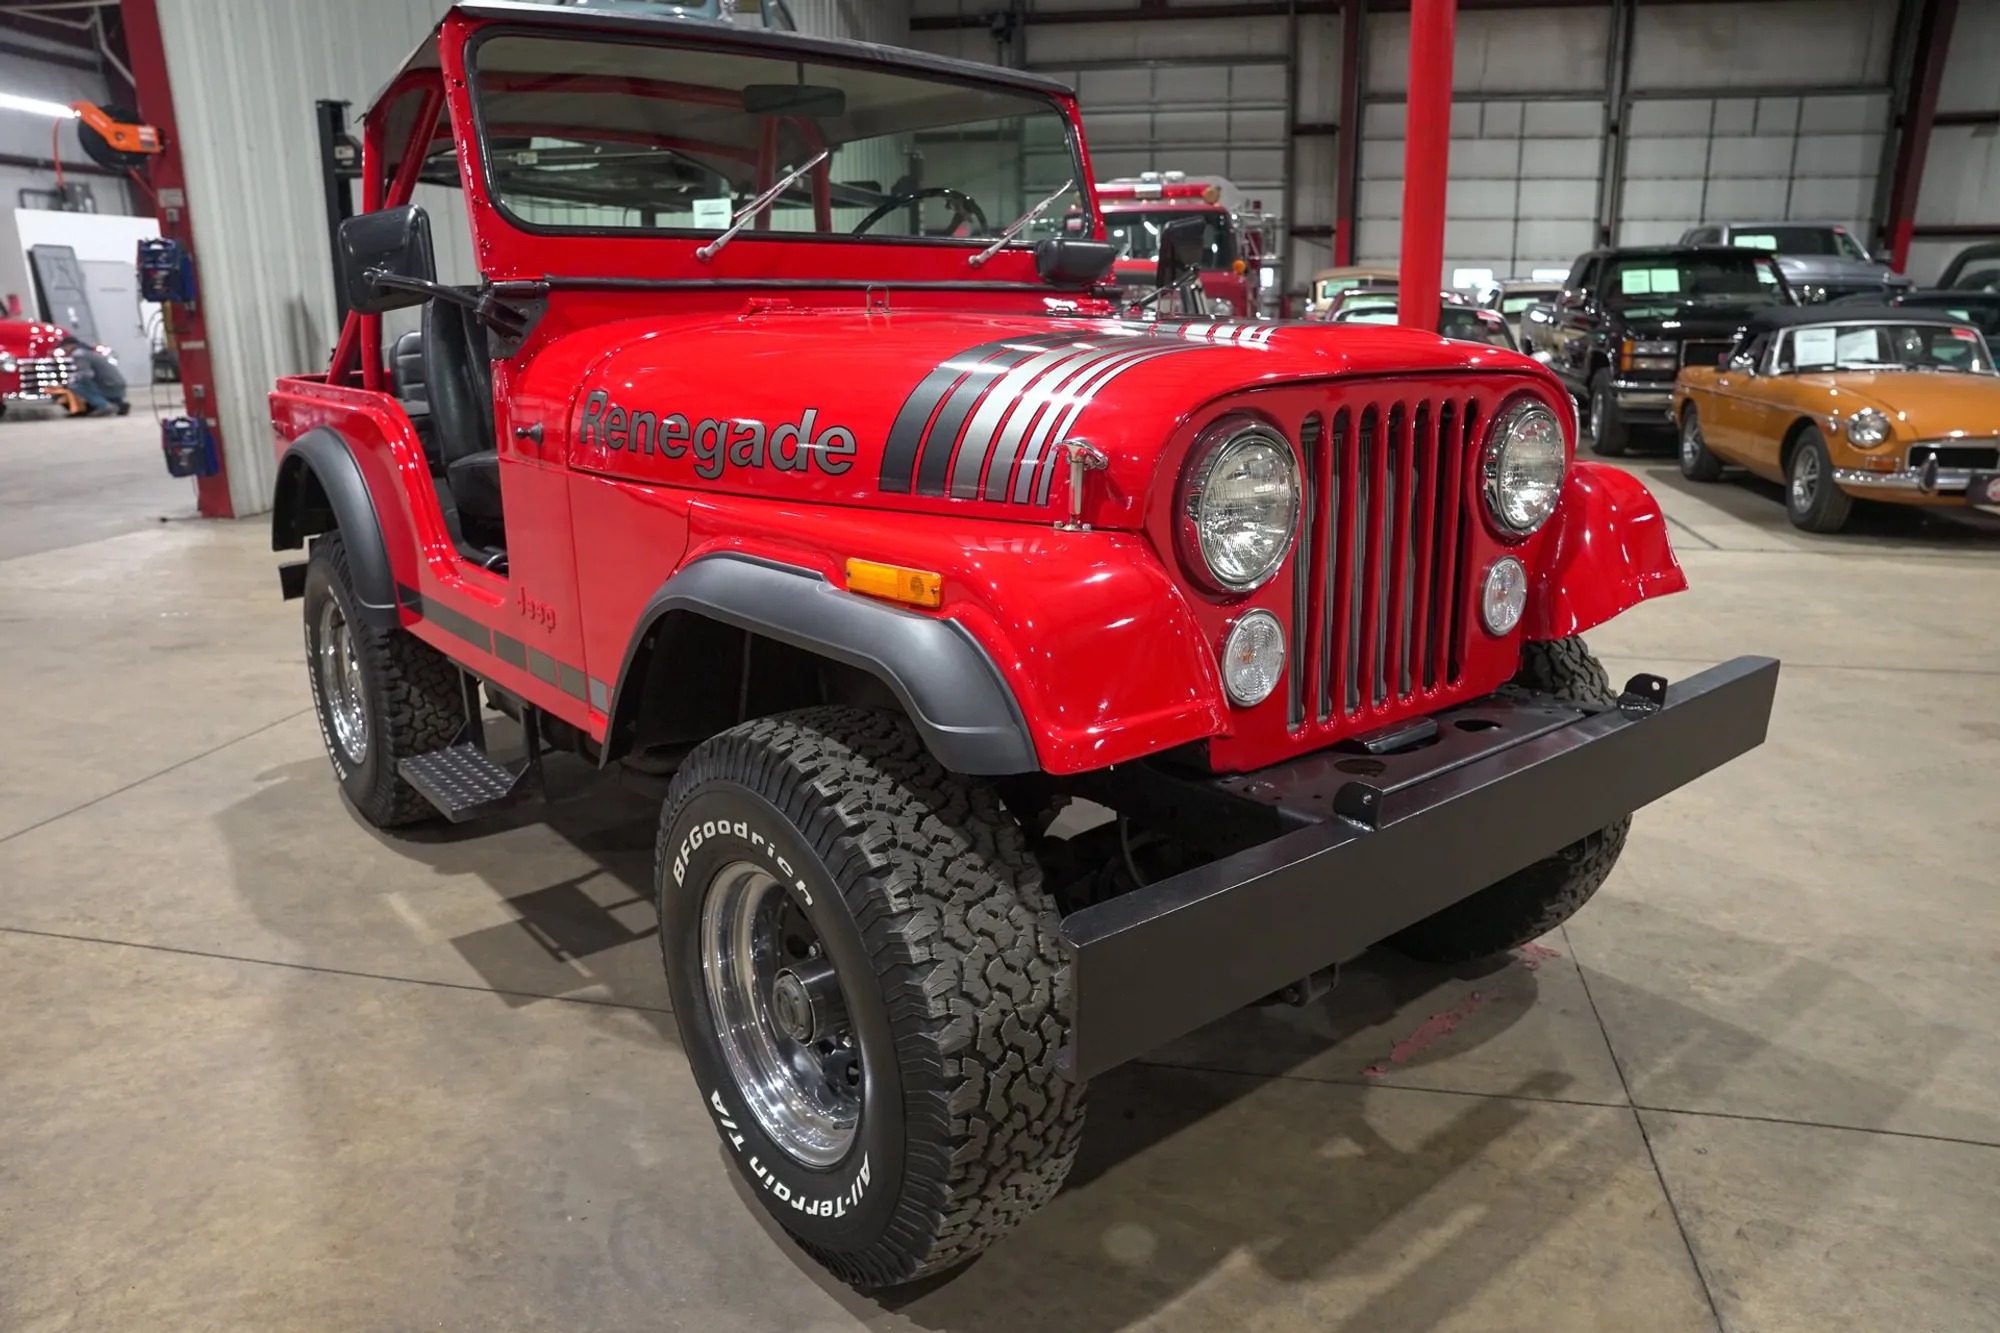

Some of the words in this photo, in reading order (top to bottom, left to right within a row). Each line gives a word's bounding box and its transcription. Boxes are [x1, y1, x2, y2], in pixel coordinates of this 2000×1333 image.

[580, 389, 857, 479] Renegade
[517, 586, 557, 634] Jeep
[672, 819, 813, 907] BFGoodrich
[710, 1089, 745, 1152] T/A
[749, 1151, 872, 1219] All-Terrain
